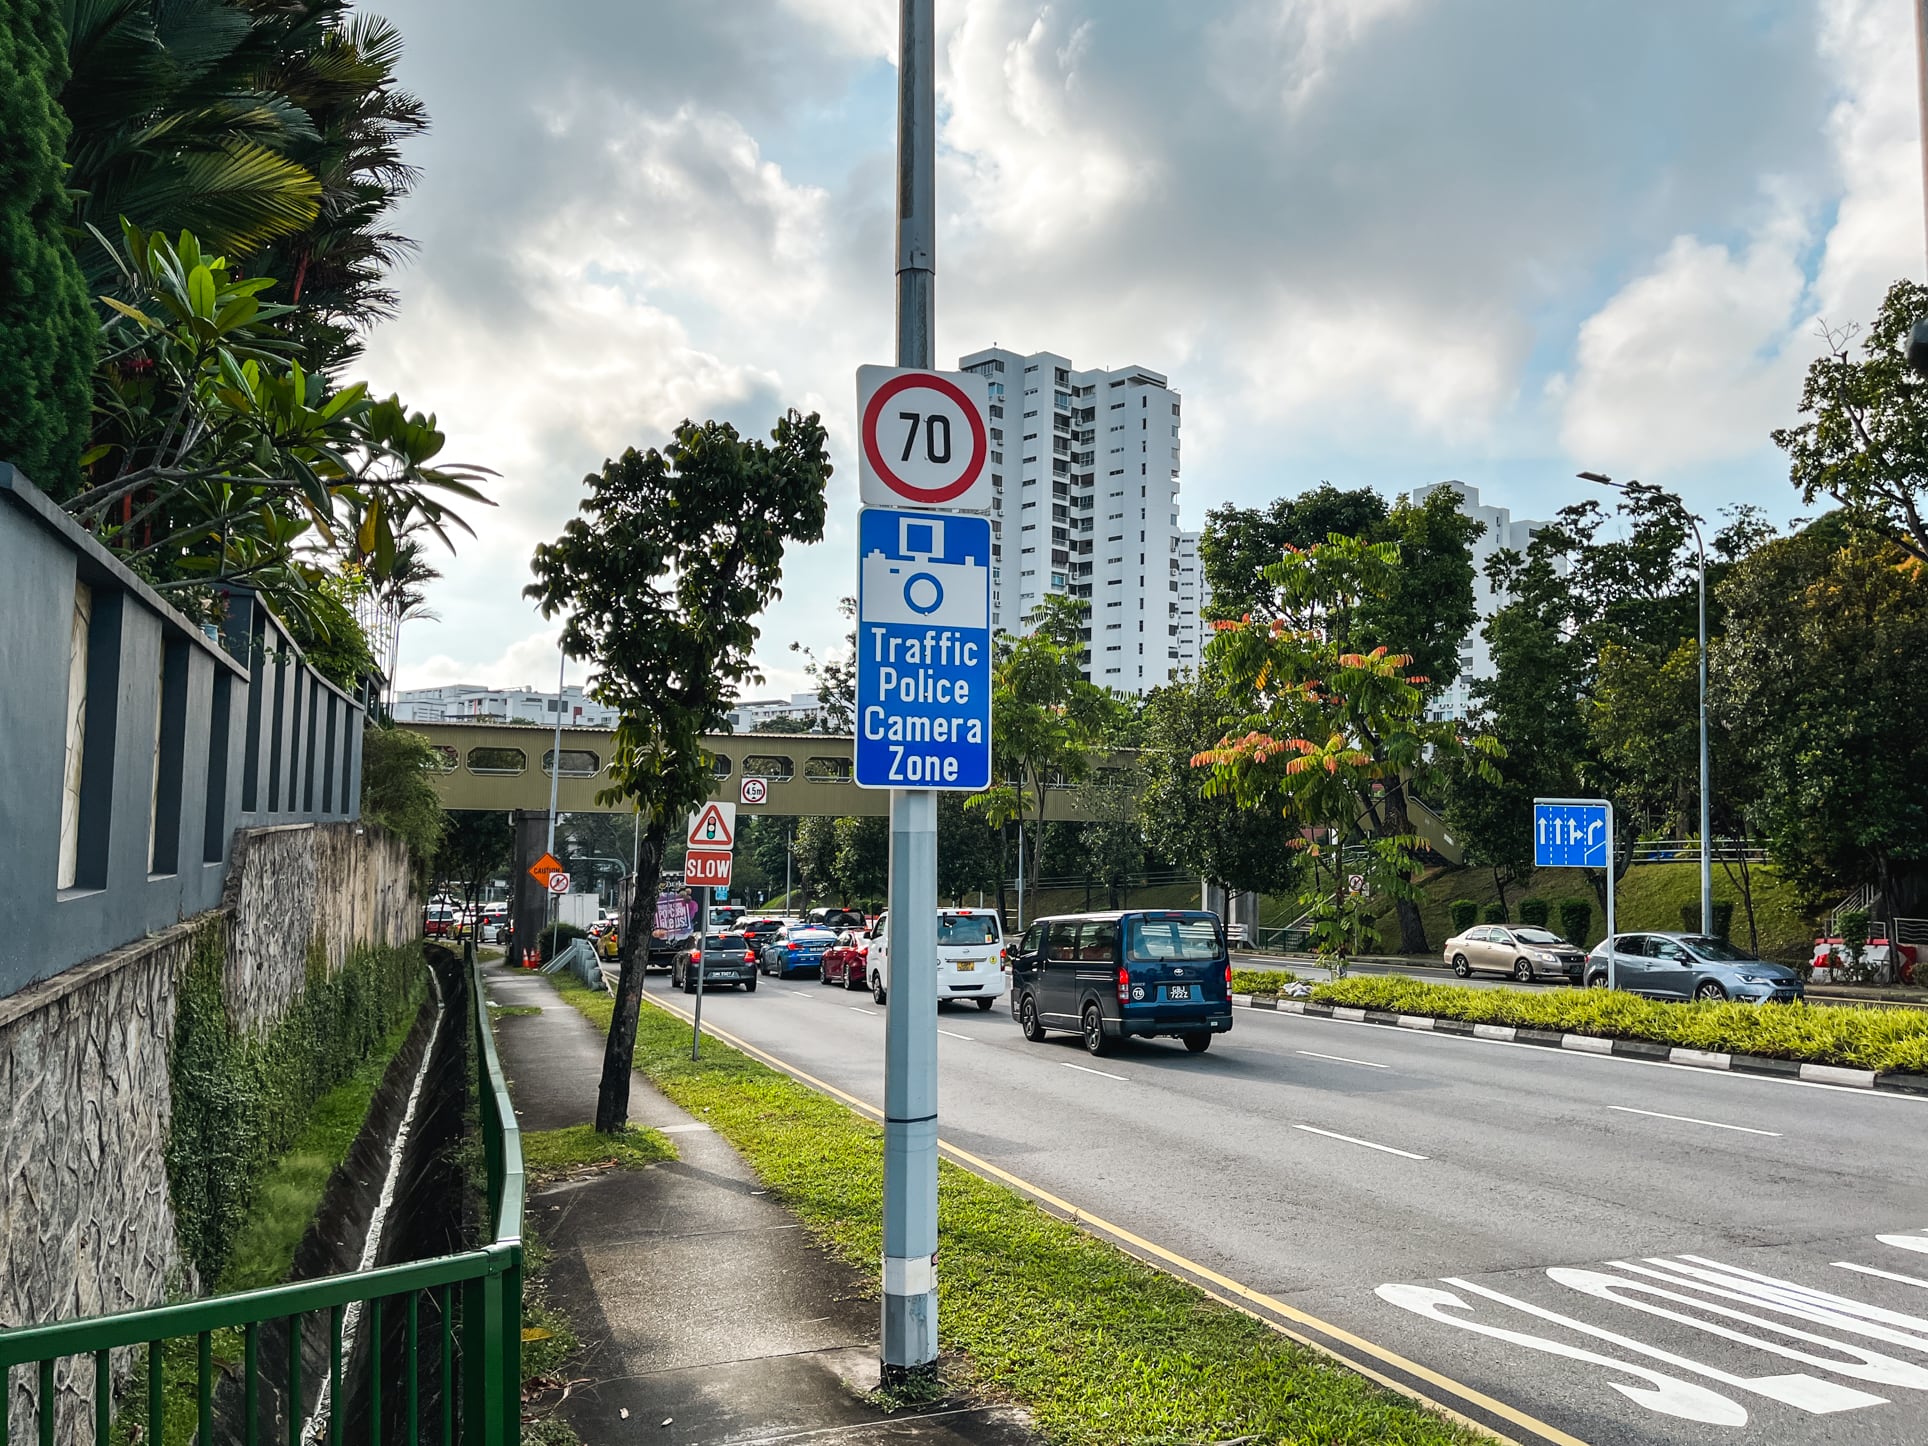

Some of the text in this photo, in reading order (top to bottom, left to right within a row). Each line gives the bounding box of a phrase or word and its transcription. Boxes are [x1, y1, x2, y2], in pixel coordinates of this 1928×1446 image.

[898, 412, 951, 464] 70
[871, 627, 979, 667] Traffic
[879, 666, 970, 704] Police
[864, 705, 982, 744] Camera
[888, 746, 959, 782] Zone
[746, 786, 763, 796] 4.5m
[687, 859, 730, 877] SLOW
